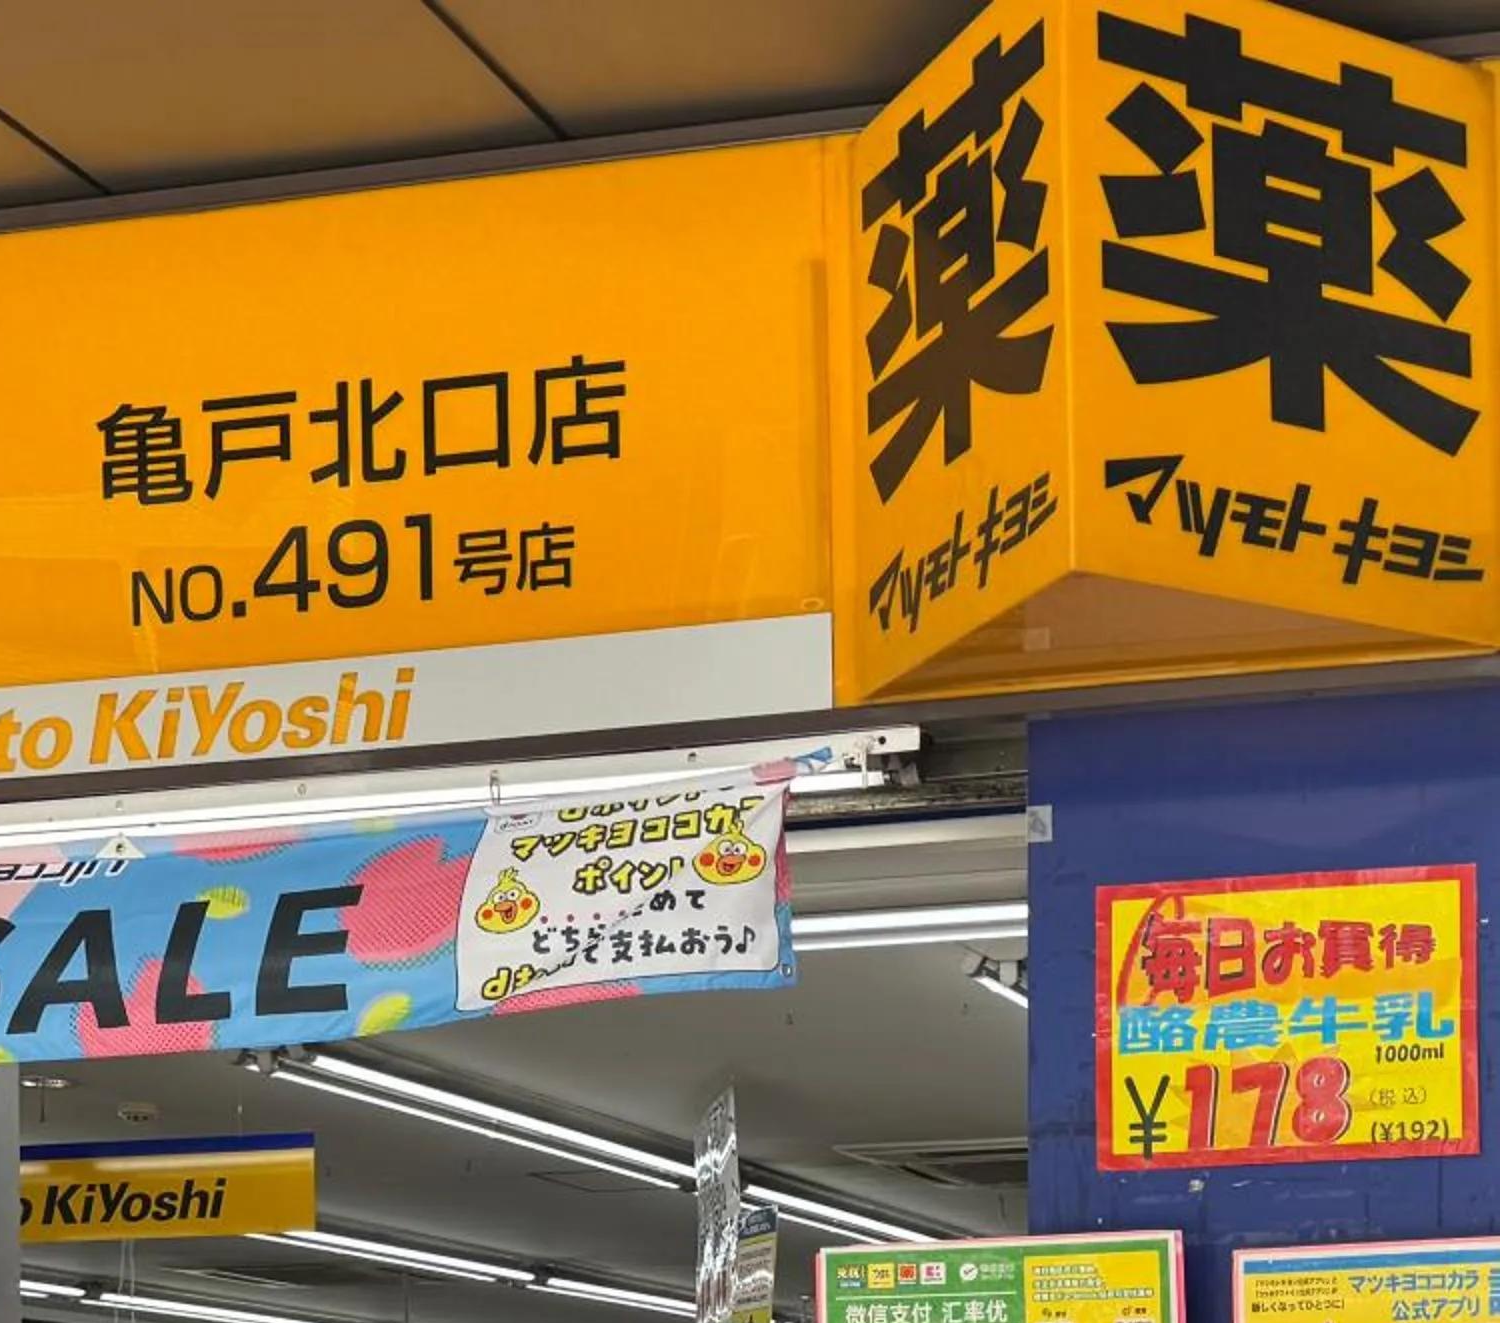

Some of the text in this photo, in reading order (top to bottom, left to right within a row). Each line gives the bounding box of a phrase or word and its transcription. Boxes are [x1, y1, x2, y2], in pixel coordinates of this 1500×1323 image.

[861, 16, 1054, 505] 薬
[1097, 10, 1480, 457] 薬
[95, 356, 627, 506] 亀戸北口店
[869, 471, 1058, 633] マツモトキヨシ
[1104, 454, 1484, 584] マツモトキヨシ
[89, 666, 416, 766] KiYoshi
[1142, 908, 1437, 1005] 毎日お買得
[1118, 992, 1454, 1055] 酪農牛乳
[1375, 1043, 1445, 1064] 1000ml
[41, 1177, 227, 1226] KiYoshi
[941, 1299, 1008, 1323] 汇率优
[1348, 1270, 1480, 1294] マツキヨココカラ
[1392, 1296, 1481, 1321] 公式アプリ
